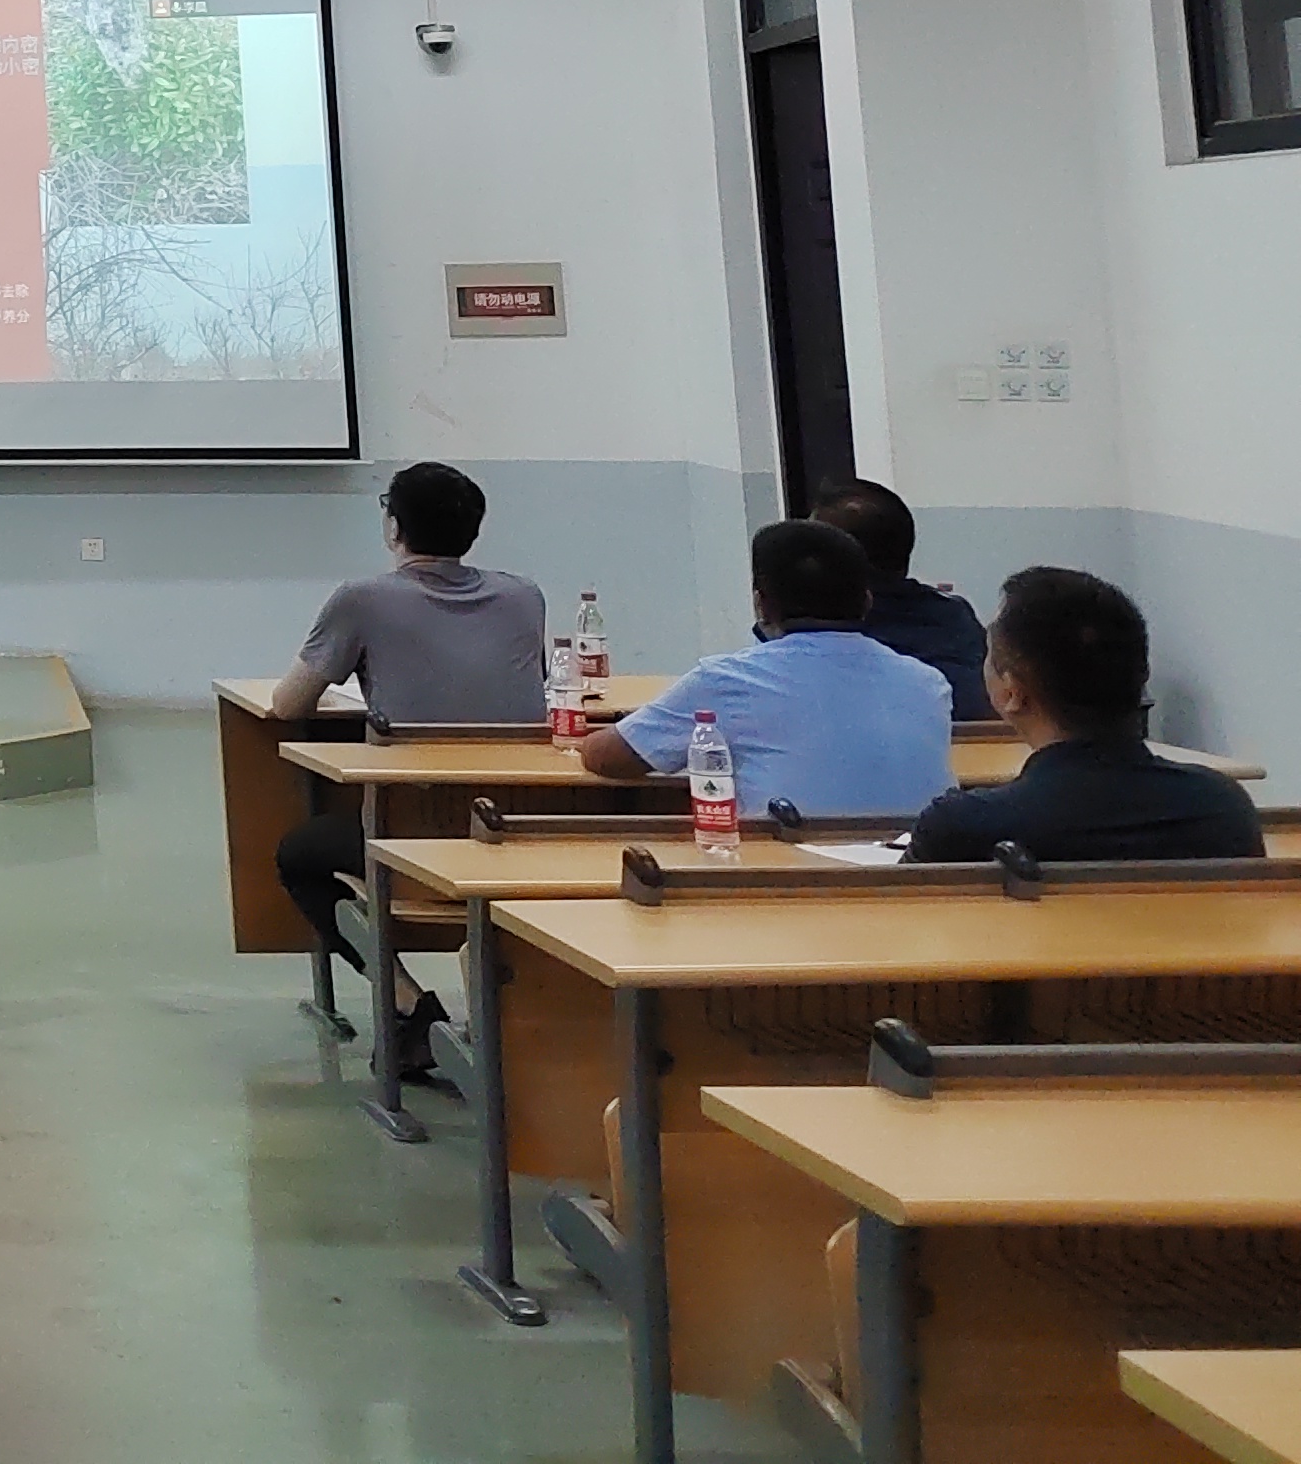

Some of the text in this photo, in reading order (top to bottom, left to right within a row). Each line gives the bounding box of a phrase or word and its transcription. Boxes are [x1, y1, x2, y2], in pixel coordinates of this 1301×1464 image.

[474, 292, 541, 306] 请勿动电源
